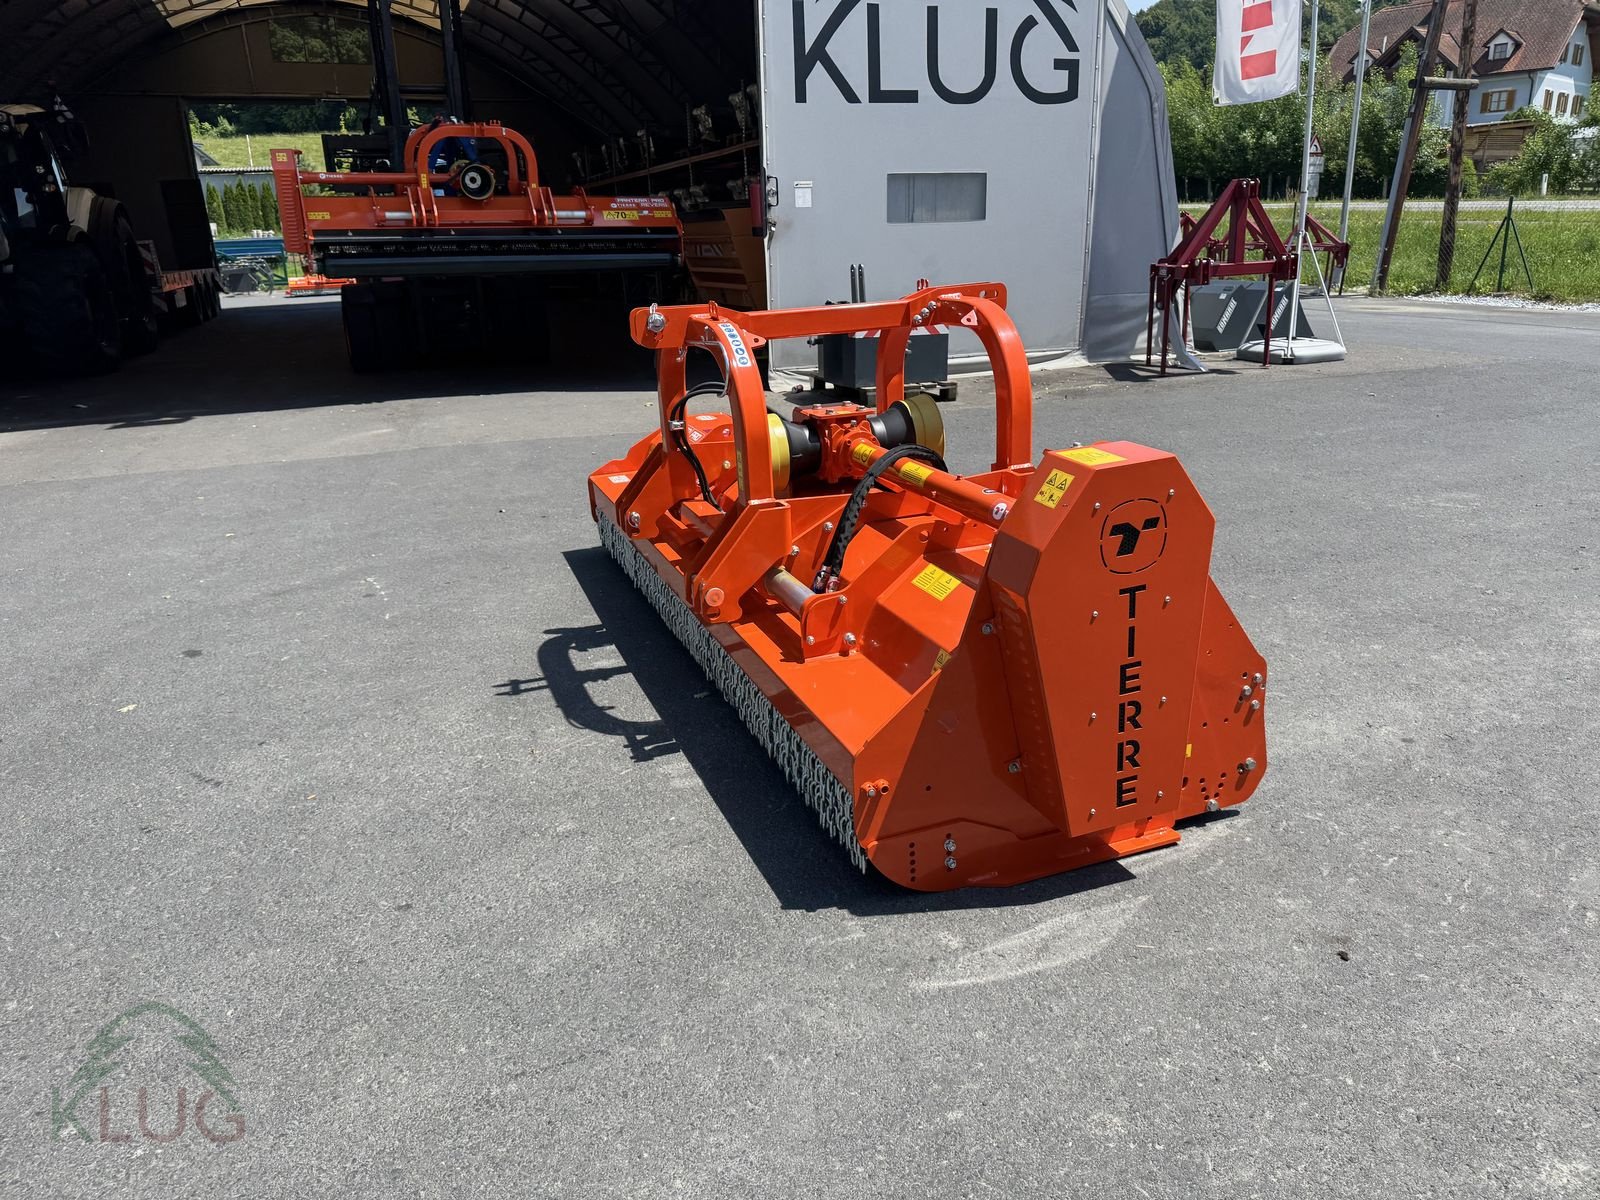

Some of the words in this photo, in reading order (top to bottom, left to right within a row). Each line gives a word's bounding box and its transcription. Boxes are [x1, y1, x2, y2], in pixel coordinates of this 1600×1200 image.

[792, 0, 1080, 105] KLUG
[614, 211, 627, 219] 70
[1116, 583, 1147, 809] TIERRE
